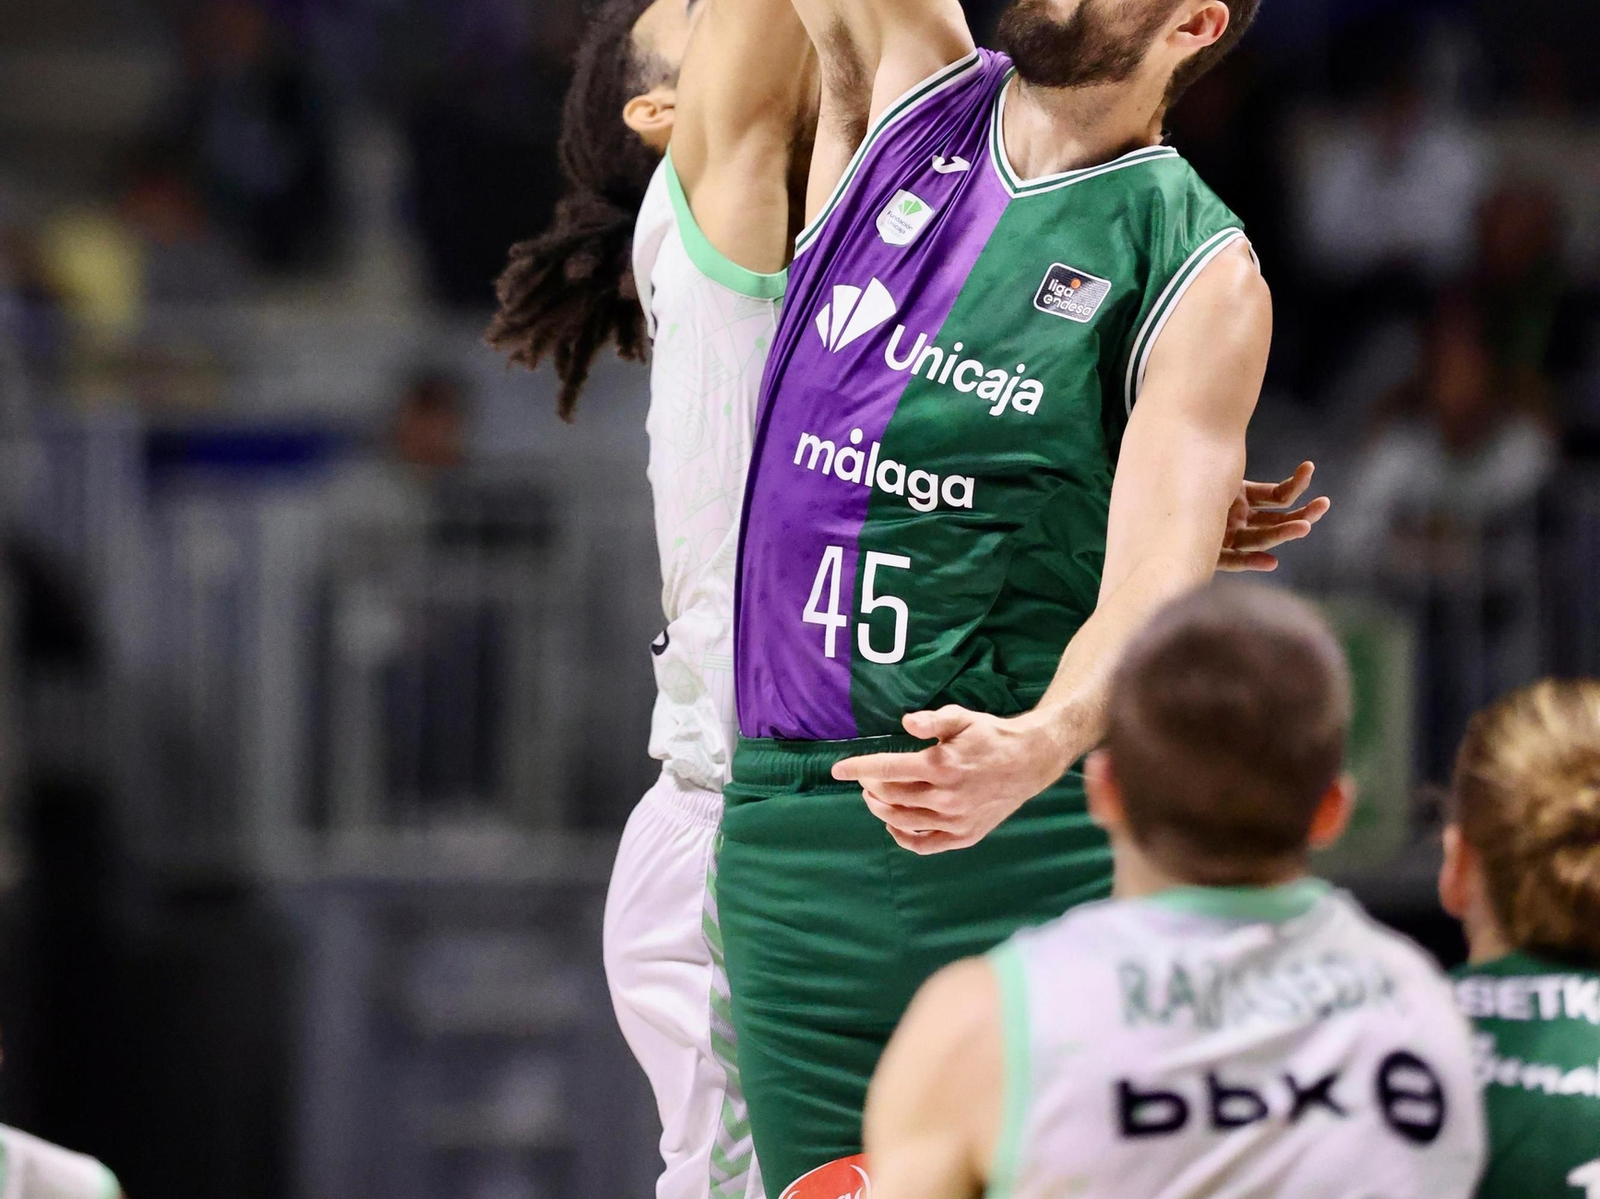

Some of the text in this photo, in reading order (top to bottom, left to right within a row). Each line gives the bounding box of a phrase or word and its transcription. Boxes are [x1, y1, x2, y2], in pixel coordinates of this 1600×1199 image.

[887, 210, 913, 231] Fundación
[1043, 294, 1092, 317] endesa
[1047, 278, 1075, 298] liga
[885, 324, 1044, 417] Unicaja
[793, 428, 975, 512] málaga
[802, 545, 911, 665] 45
